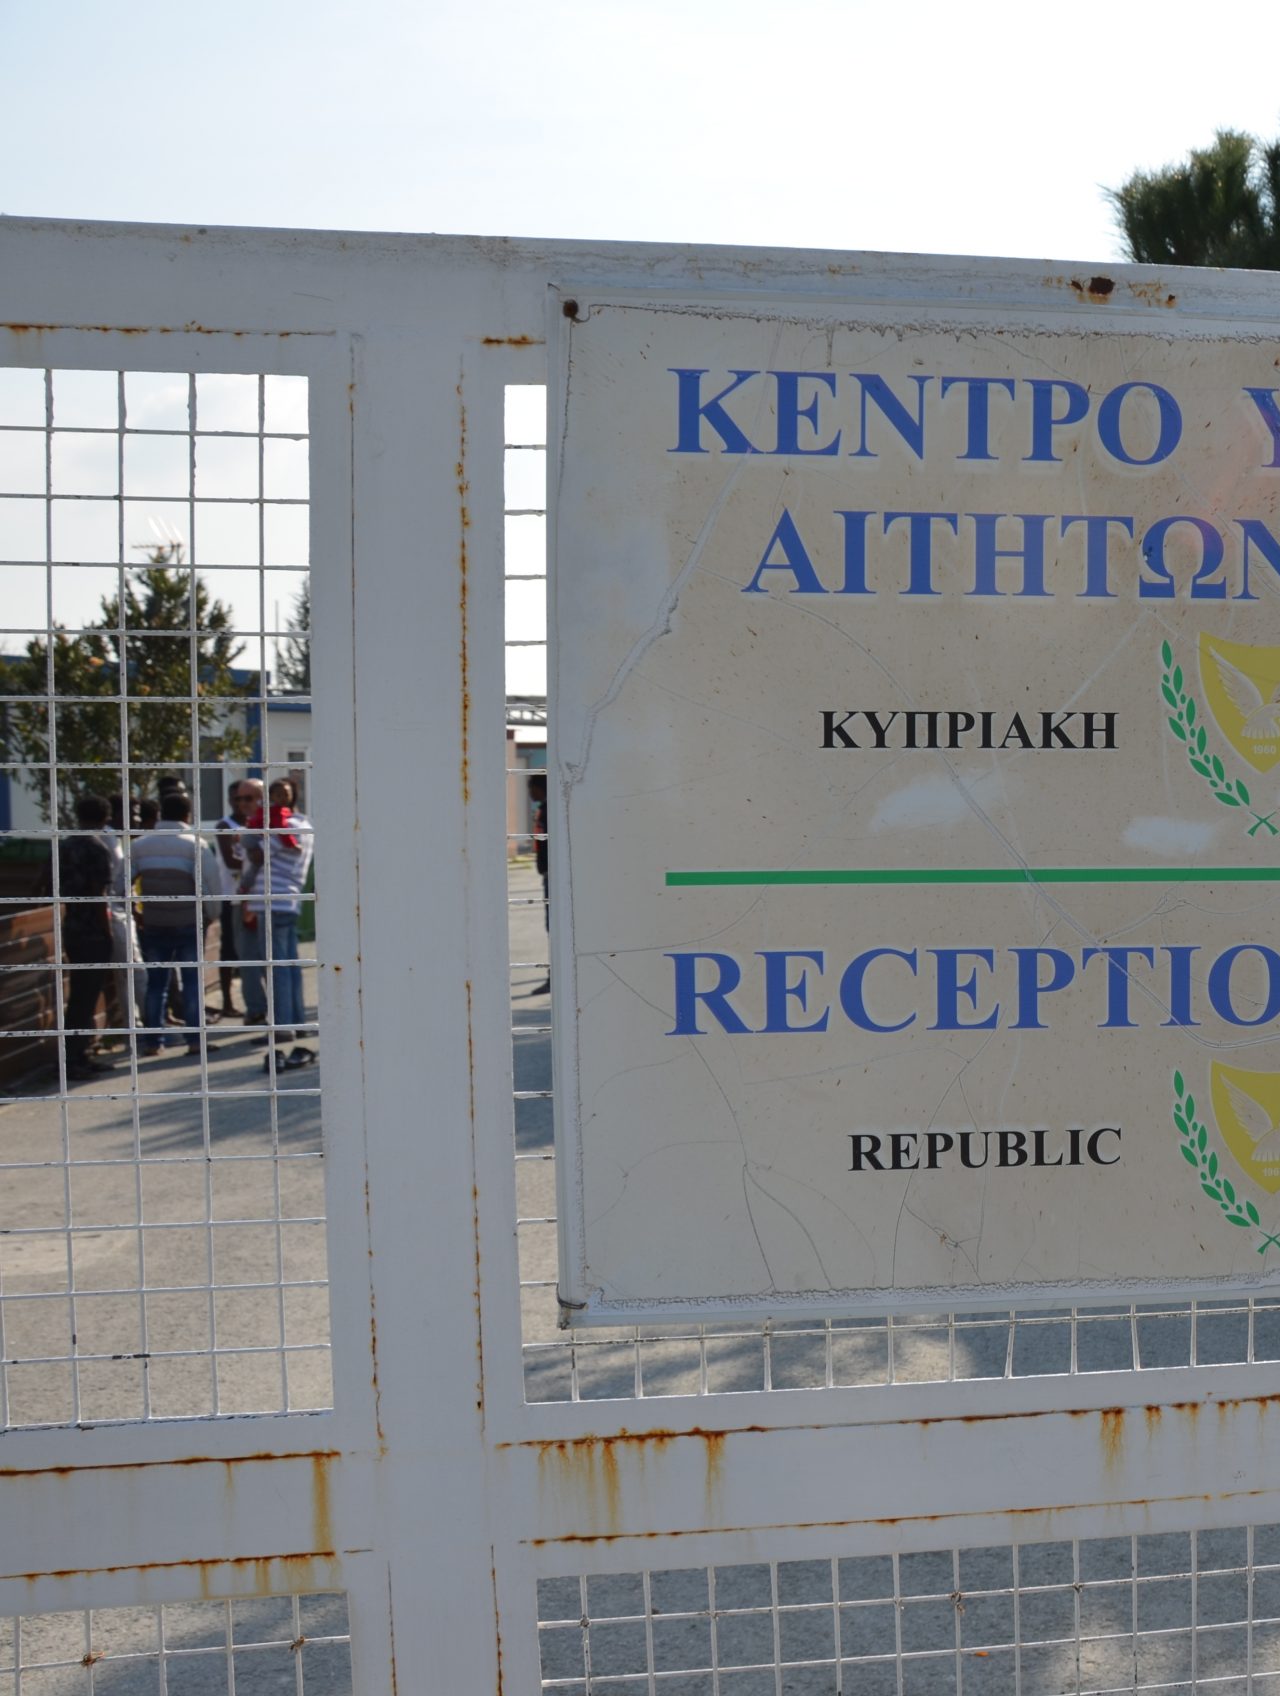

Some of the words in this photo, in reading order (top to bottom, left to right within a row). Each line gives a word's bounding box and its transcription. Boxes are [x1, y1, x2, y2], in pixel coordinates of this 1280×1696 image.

[667, 368, 1184, 466] ΚΕΝΤΡΟ
[818, 710, 1120, 749] ΚΥΠΡΙΑΚΗ
[848, 1128, 1122, 1172] REPUBLIC
